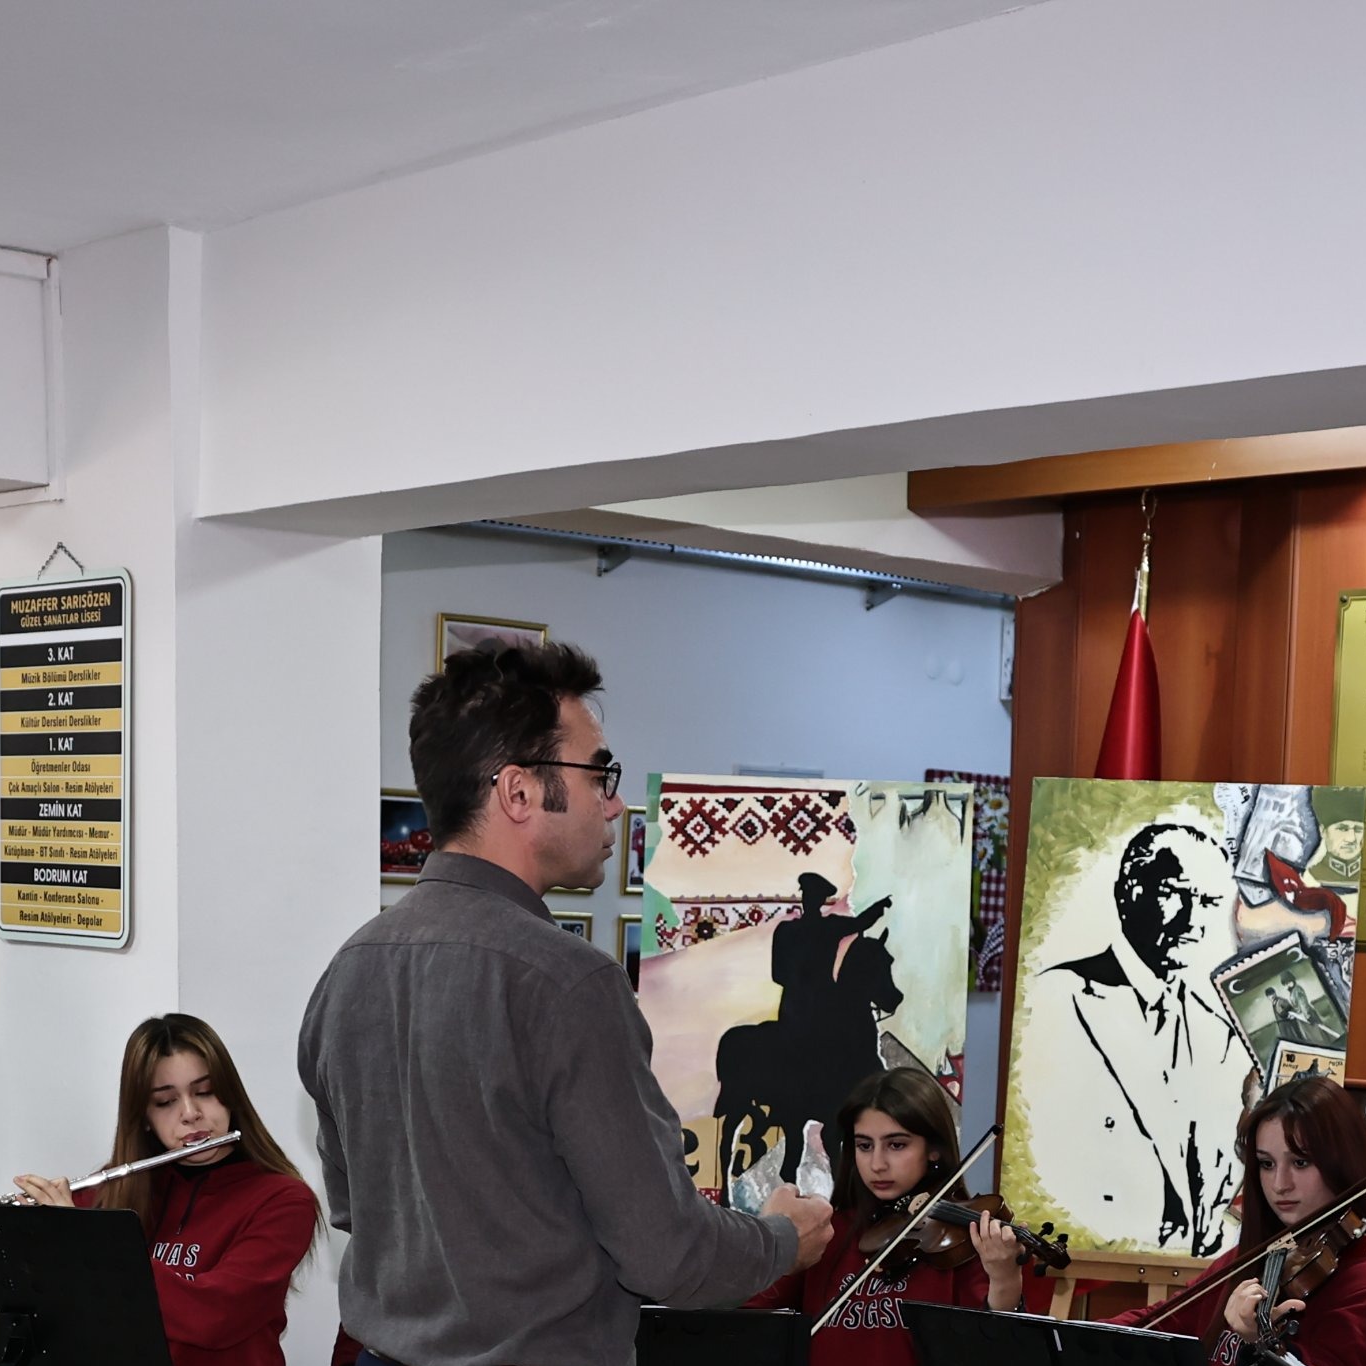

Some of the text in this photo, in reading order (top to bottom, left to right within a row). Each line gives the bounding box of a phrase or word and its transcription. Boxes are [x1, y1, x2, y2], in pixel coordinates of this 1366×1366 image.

[10, 590, 111, 614] MUZAFFER SARISÖZEN
[20, 608, 101, 628] GÜZEL SANATLAR LİSESİ
[47, 646, 74, 662] 3. KAT
[21, 669, 101, 684] Müzik Bölümü Derslikler
[47, 691, 74, 706] 2. KAT
[20, 714, 101, 728] Kültür Dersleri Derslikler
[48, 737, 74, 752] 1. KAT
[31, 758, 90, 774] Öğretmenler Odası
[8, 782, 19, 795] Çok
[21, 781, 42, 795] Amaçlı
[43, 782, 60, 793] Salon
[65, 782, 83, 793] Resim
[84, 781, 113, 795] Atölyeleri
[39, 800, 82, 818] ZEMİN KAT
[8, 825, 27, 837] Müdür
[32, 825, 51, 837] Müdür
[52, 826, 84, 838] Yardımcısı
[89, 827, 110, 839] Memur
[4, 845, 35, 859] Kütüphane
[40, 846, 48, 857] BT
[69, 847, 88, 858] Resim
[88, 847, 117, 862] Atölyeleri
[33, 868, 88, 884] BODRUM KAT
[17, 890, 38, 901] Kantin
[43, 891, 76, 903] Konferans
[77, 893, 100, 905] Salonu
[19, 910, 39, 922] Resim
[40, 911, 71, 926] Atölyeleri
[77, 914, 102, 928] Depolar
